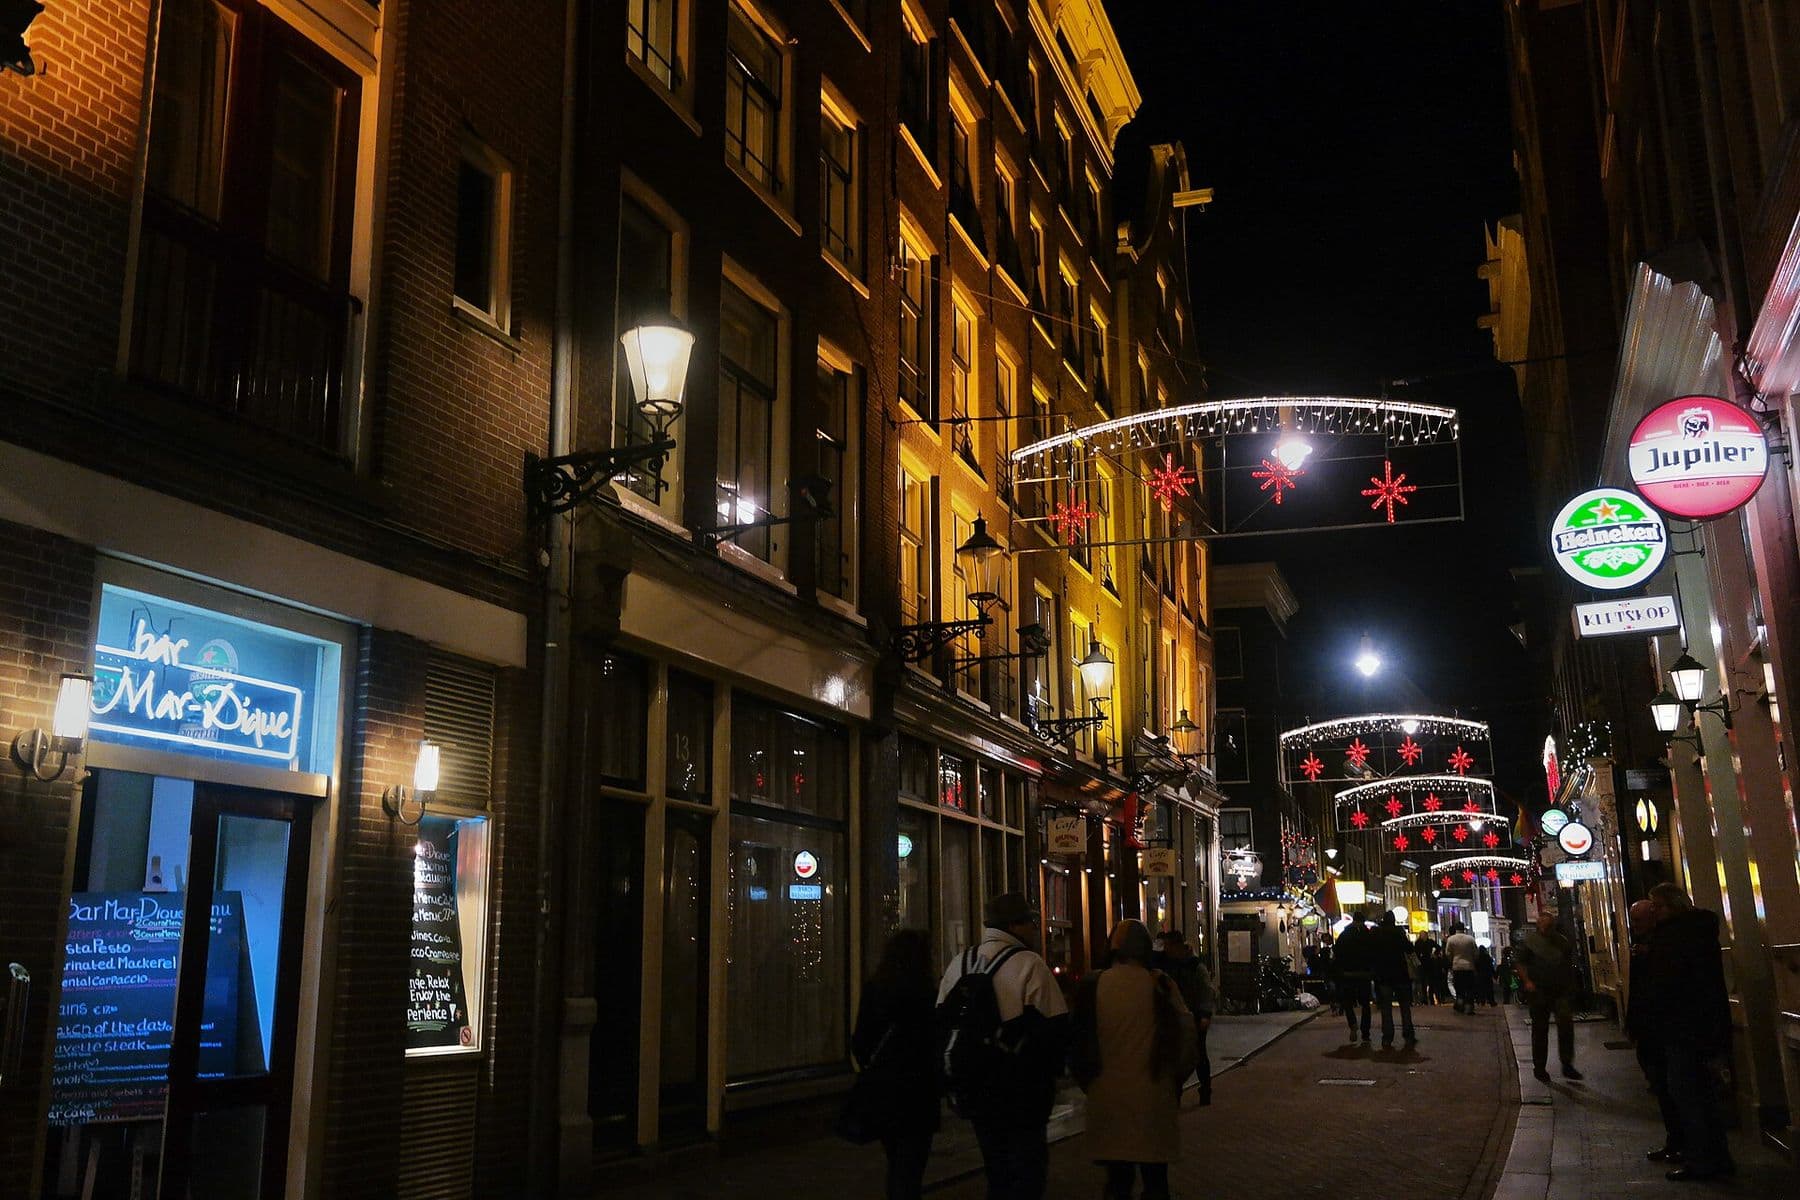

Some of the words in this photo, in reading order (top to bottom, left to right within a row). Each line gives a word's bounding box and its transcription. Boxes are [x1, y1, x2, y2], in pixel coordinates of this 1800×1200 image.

[1645, 440, 1755, 473] Jupiler
[1559, 523, 1660, 551] Heineken
[135, 618, 189, 666] bar
[90, 665, 292, 749] Mar-Dique
[675, 732, 690, 762] 13
[92, 937, 131, 954] Pesto
[64, 957, 116, 970] rinated
[117, 955, 177, 970] Mackerel
[426, 974, 450, 989] Relax
[436, 990, 451, 1001] the
[94, 1020, 109, 1034] of
[112, 1020, 135, 1033] the
